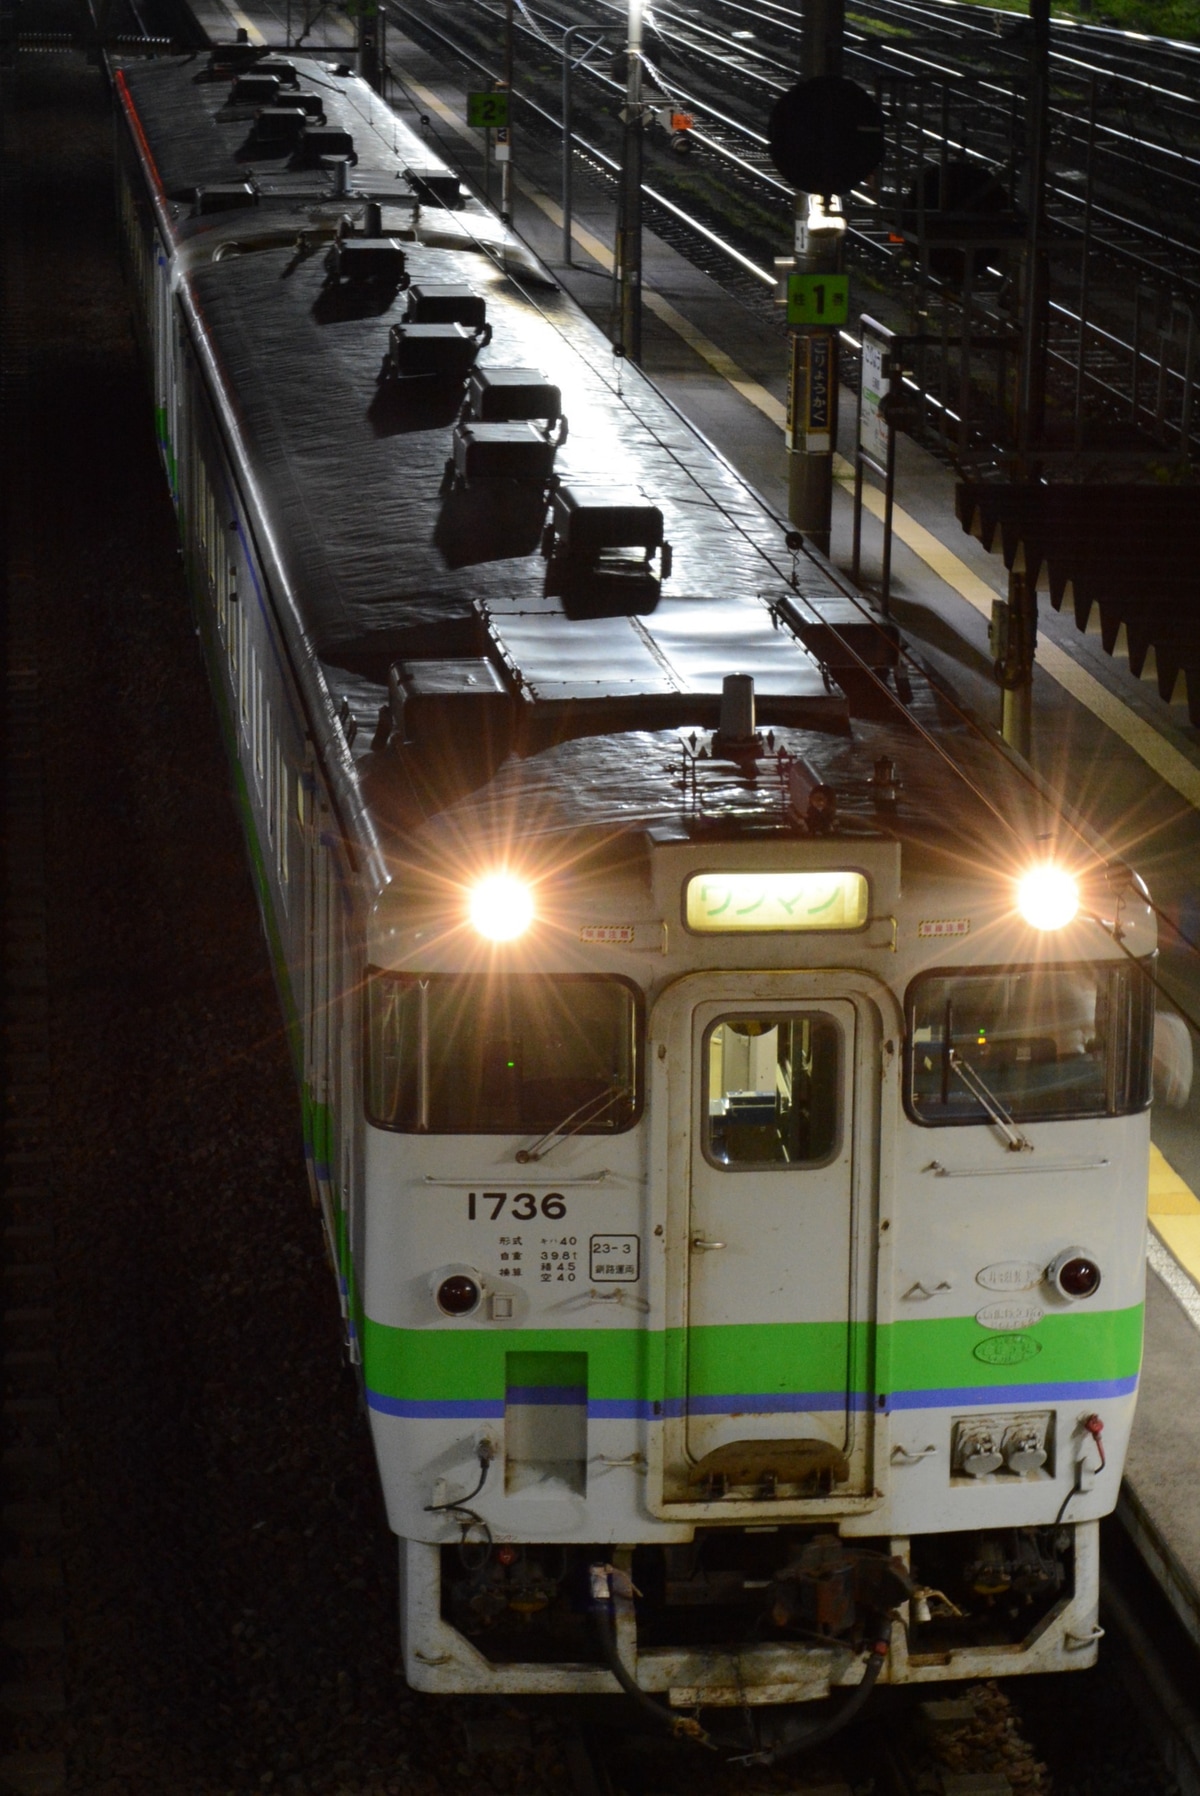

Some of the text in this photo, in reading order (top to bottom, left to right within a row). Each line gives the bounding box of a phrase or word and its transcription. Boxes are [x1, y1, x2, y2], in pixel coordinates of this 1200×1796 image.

[482, 100, 497, 120] 2
[813, 284, 825, 314] 1
[468, 1192, 567, 1221] 1736
[499, 1236, 523, 1247] 形式
[499, 1252, 523, 1261] 自重
